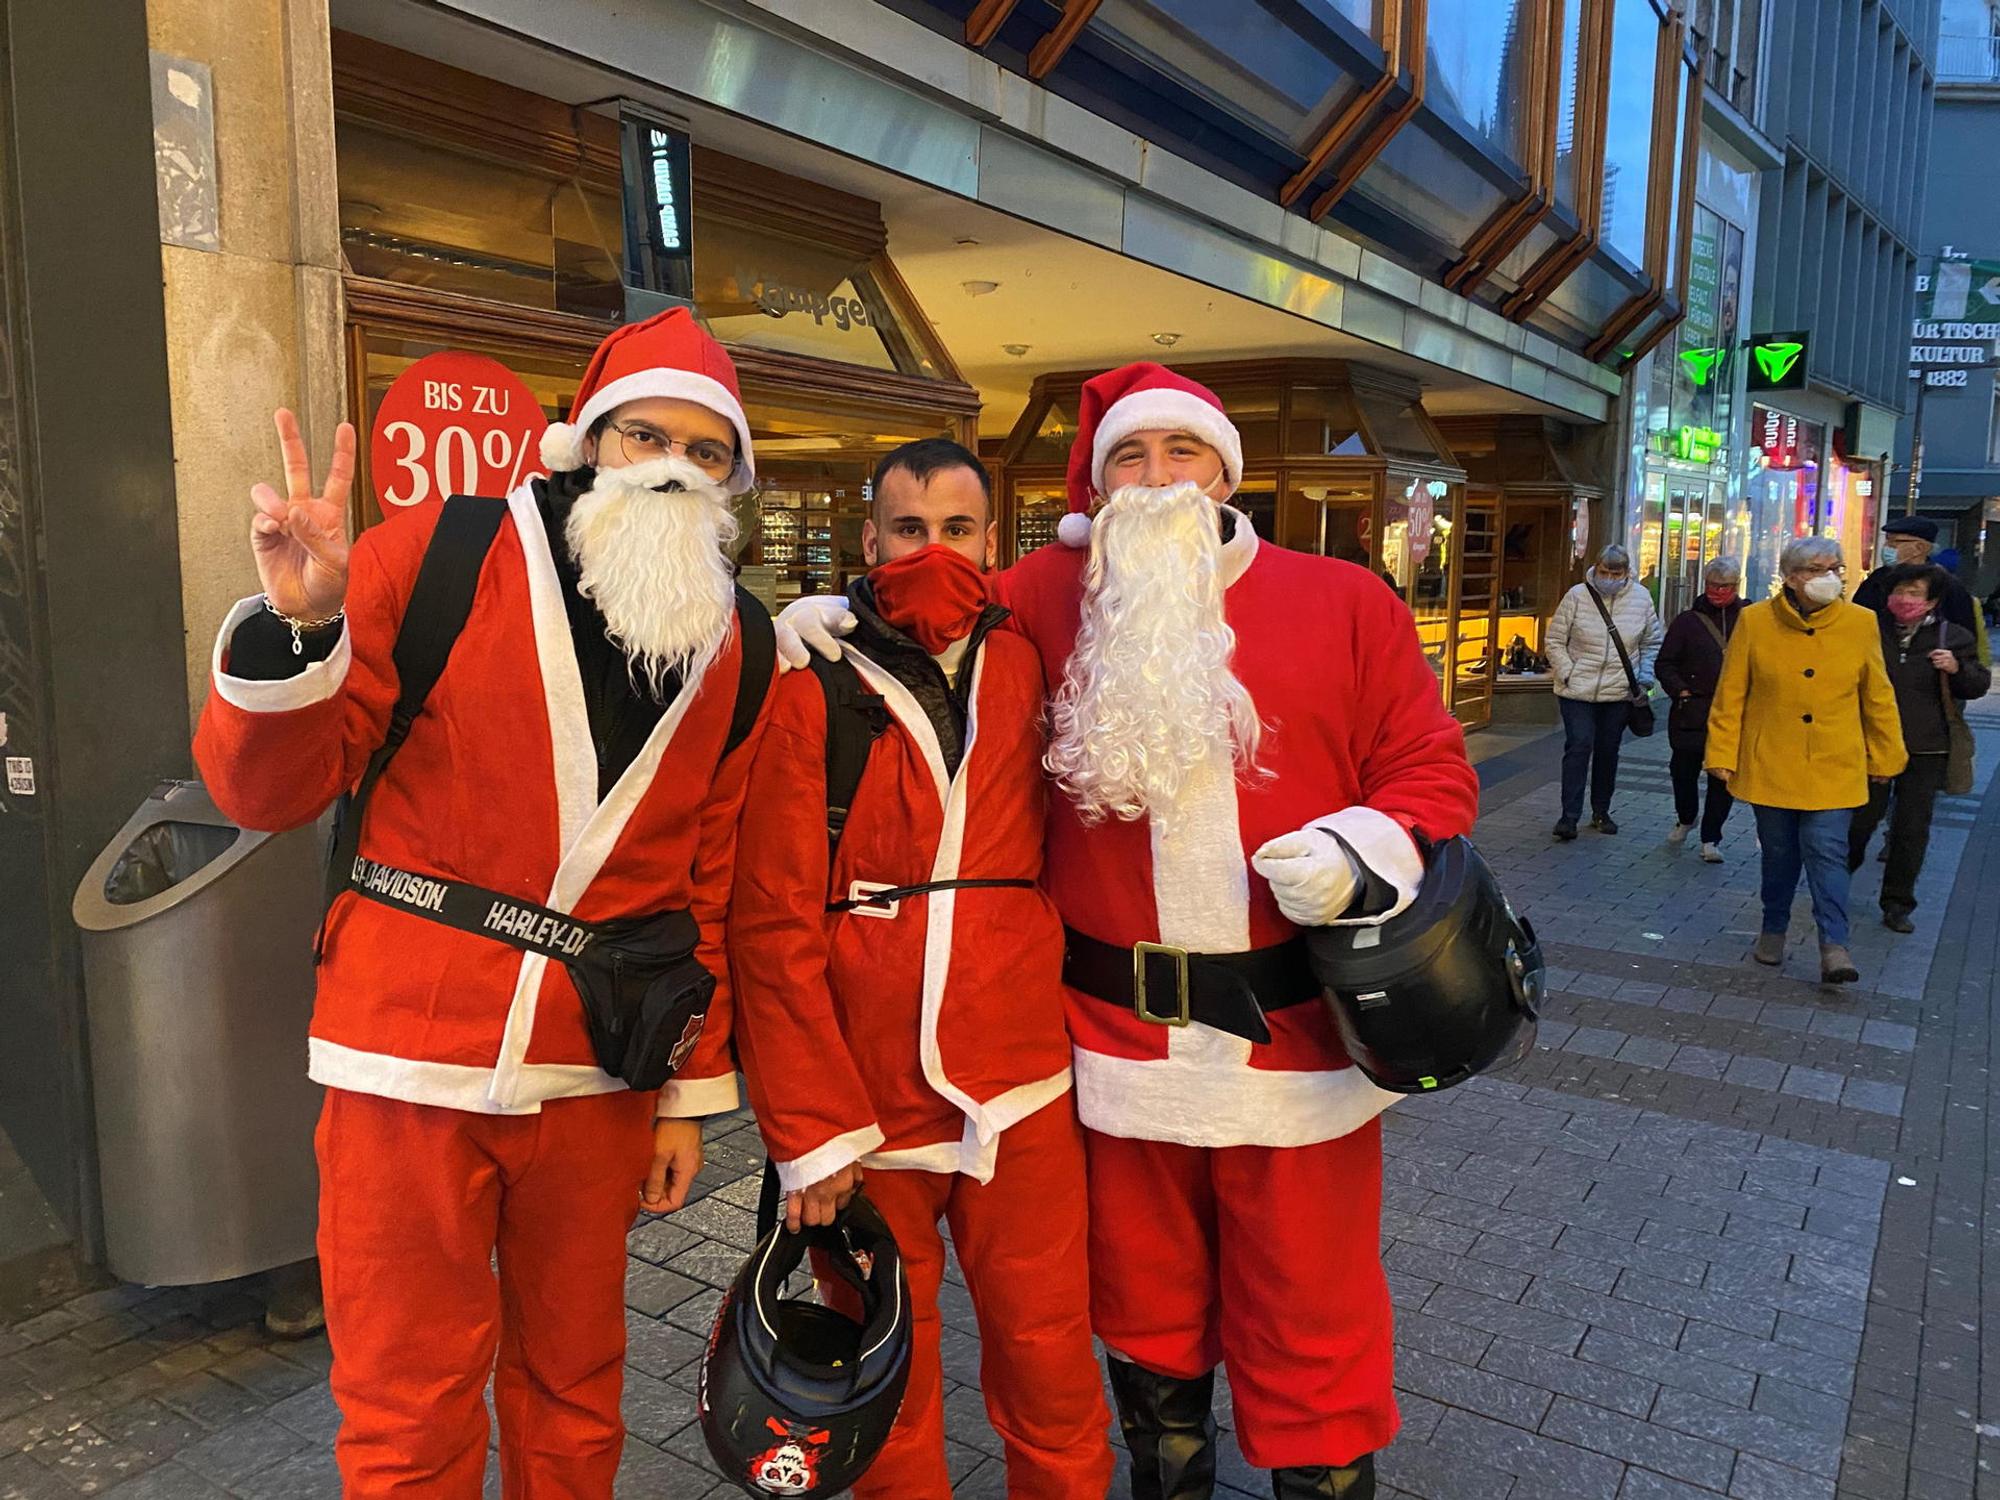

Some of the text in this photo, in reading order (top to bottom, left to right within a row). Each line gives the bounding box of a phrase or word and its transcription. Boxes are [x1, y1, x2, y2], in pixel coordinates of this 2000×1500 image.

[1909, 345, 1984, 363] KULTUR
[1926, 370, 1967, 386] 1882
[424, 380, 509, 416] BIS ZU
[383, 421, 548, 507] 30%
